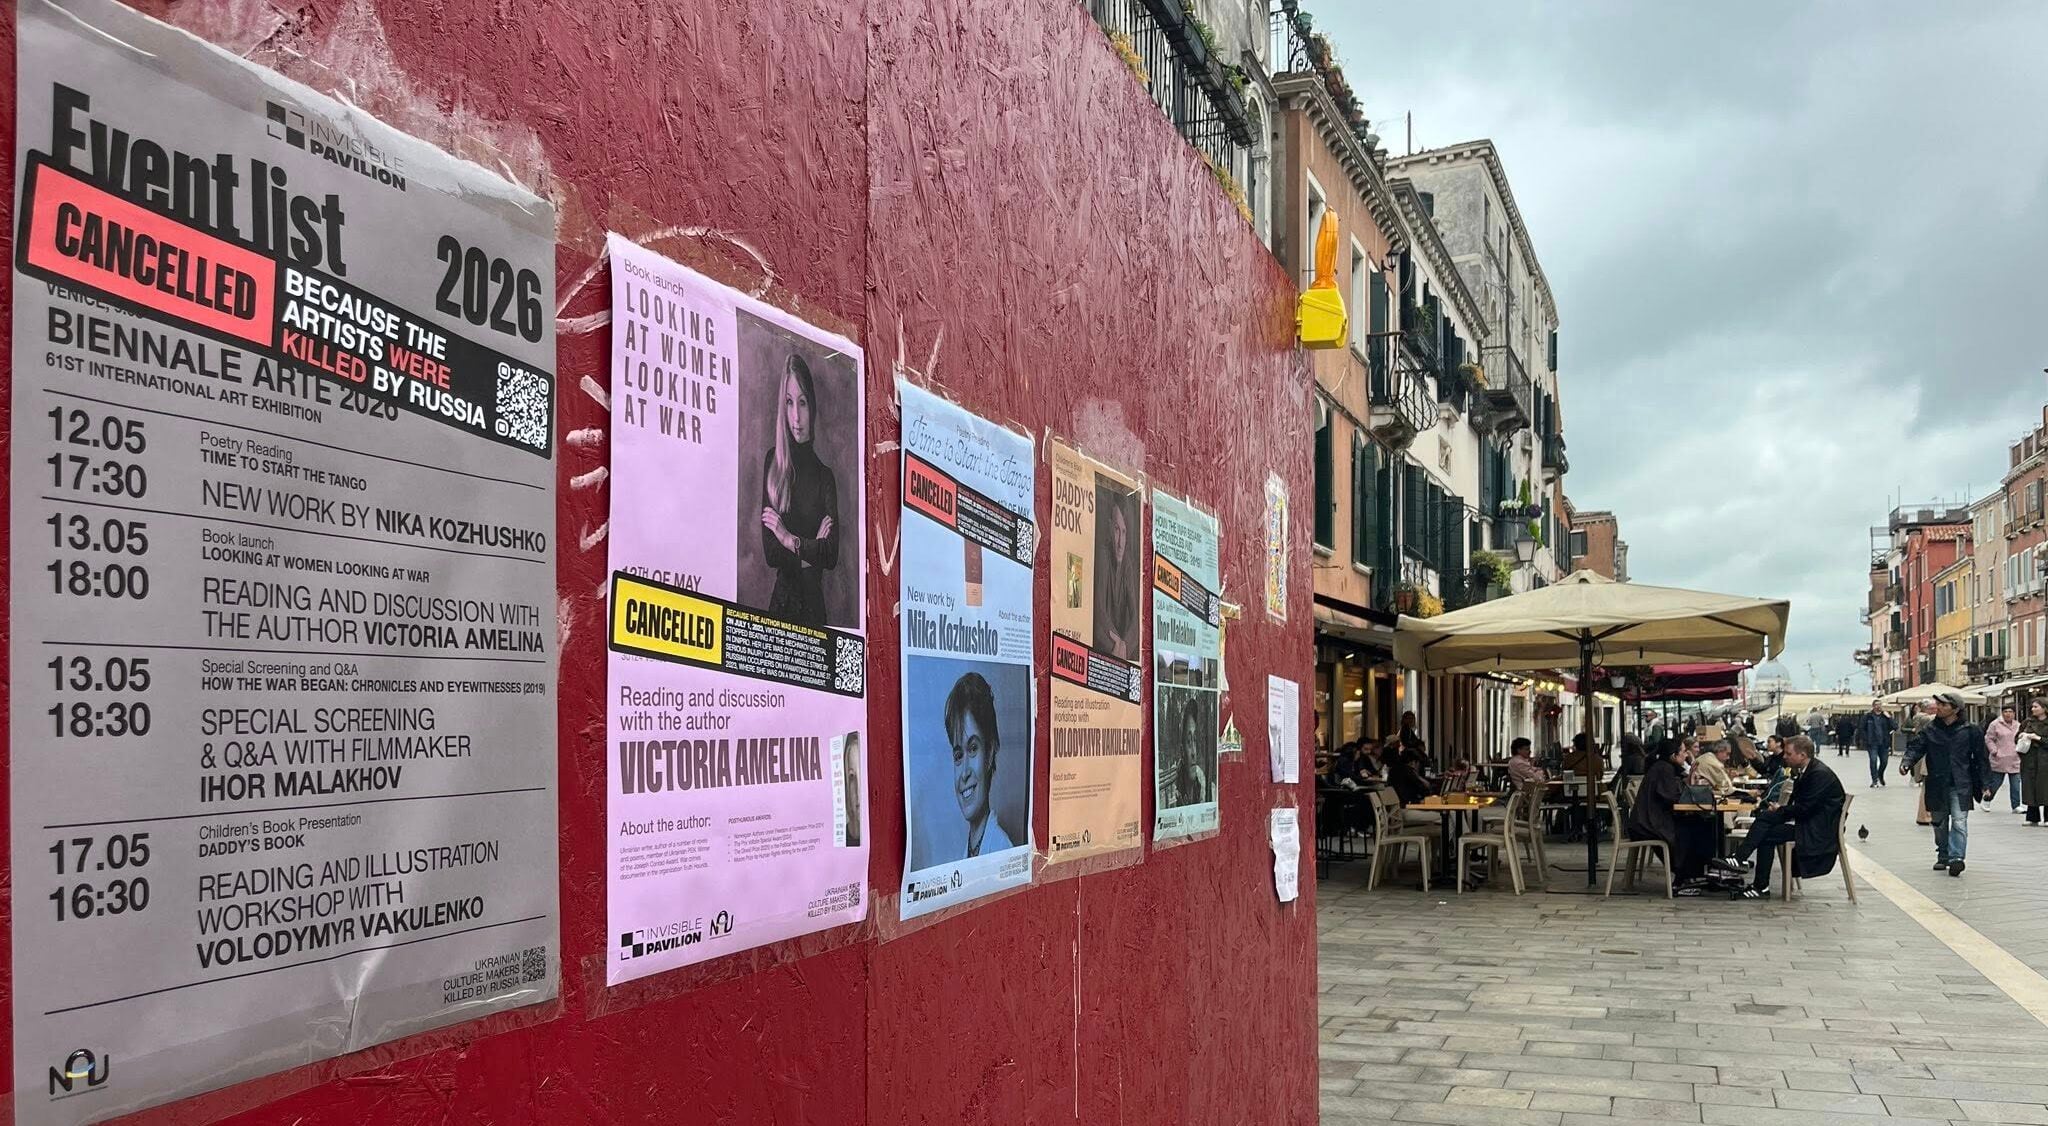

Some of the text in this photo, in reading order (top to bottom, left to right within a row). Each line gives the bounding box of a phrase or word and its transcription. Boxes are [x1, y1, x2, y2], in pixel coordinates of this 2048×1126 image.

[310, 139, 406, 192] PAVILION
[311, 120, 404, 173] INVISIBLE
[52, 82, 346, 277] Event list
[55, 202, 257, 320] CANCELLED
[625, 259, 684, 297] Book launch
[437, 235, 542, 343] 2026
[285, 268, 447, 360] BECAUSE THE
[626, 282, 715, 346] LOOKING
[47, 307, 242, 383] BIENNALE
[252, 358, 332, 405] ARTE
[282, 300, 450, 390] ARTISTS WERE
[625, 320, 731, 385] AT WOMEN
[46, 352, 322, 424] 61ST INTERNATIONAL ART EXHIBITION
[282, 328, 486, 429] KILLED BY RUSSIA
[624, 356, 716, 414] LOOKING
[48, 406, 146, 454] 12.05
[625, 394, 702, 444] AT WAR
[200, 431, 293, 463] Poetry Reading
[47, 452, 147, 498] 17:30
[200, 448, 367, 491] TIME TO START THE TANGO
[911, 470, 952, 516] CANCELLED
[1056, 477, 1094, 514] DADDY'S
[47, 512, 149, 556] 13.05
[202, 479, 546, 553] NEW WORK BY NIKA KOZHUSHKO
[1055, 503, 1082, 535] BOOK
[202, 528, 275, 551] Book launch
[47, 559, 149, 600] 18:00
[202, 546, 430, 583] LOOKING AT WOMEN LOOKING AT WAR
[674, 572, 702, 592] MAY
[203, 577, 539, 627] READING AND DISCUSSION WITH
[907, 585, 955, 611] New work by
[202, 610, 545, 653] THE AUTHOR VICTORIA AMELINA
[626, 599, 714, 650] CANCELLED
[726, 608, 750, 620] BECAUSE
[750, 615, 760, 623] THE
[761, 617, 780, 628] AUTHOR
[781, 622, 791, 631] WAS
[792, 625, 807, 635] KILLED
[908, 609, 937, 650] Nika
[939, 613, 998, 656] Kozhushko
[47, 656, 151, 691] 13.05
[202, 659, 359, 677] Special Screening and Q&A
[202, 677, 546, 696] HOW THE WAR BEGAN: CHRONICLES AND EYEWITNESSES (2019)
[620, 686, 785, 711] Reading and discussion
[48, 702, 151, 737] 18:30
[201, 708, 435, 735] SPECIAL SCREENING
[620, 711, 731, 731] with the author
[201, 735, 471, 769] & Q&A WITH FILMMAKER
[1054, 727, 1101, 758] VOLODYMYR
[200, 766, 402, 802] IHOR MALAKHOV
[620, 736, 822, 795] VICTORIA AMELINA
[199, 814, 361, 840] Children's Book Presentation
[199, 834, 304, 857] DADDY'S BOOK
[620, 815, 711, 836] About the author:
[49, 833, 150, 874] 17.05
[199, 840, 499, 902] READING AND ILLUSTRATION
[49, 877, 151, 921] 16:30
[198, 881, 403, 935] WORKSHOP WITH
[920, 885, 948, 900] PAVILION
[197, 896, 484, 968] VOLODYMYR VAKULENKO
[647, 918, 702, 940] INVISIBLE
[647, 931, 701, 955] PAVILION
[444, 964, 519, 991] CULTURE MAKERS
[475, 952, 520, 970] UKRAINIAN
[444, 976, 519, 1004] KILLED BY RUSSIA
